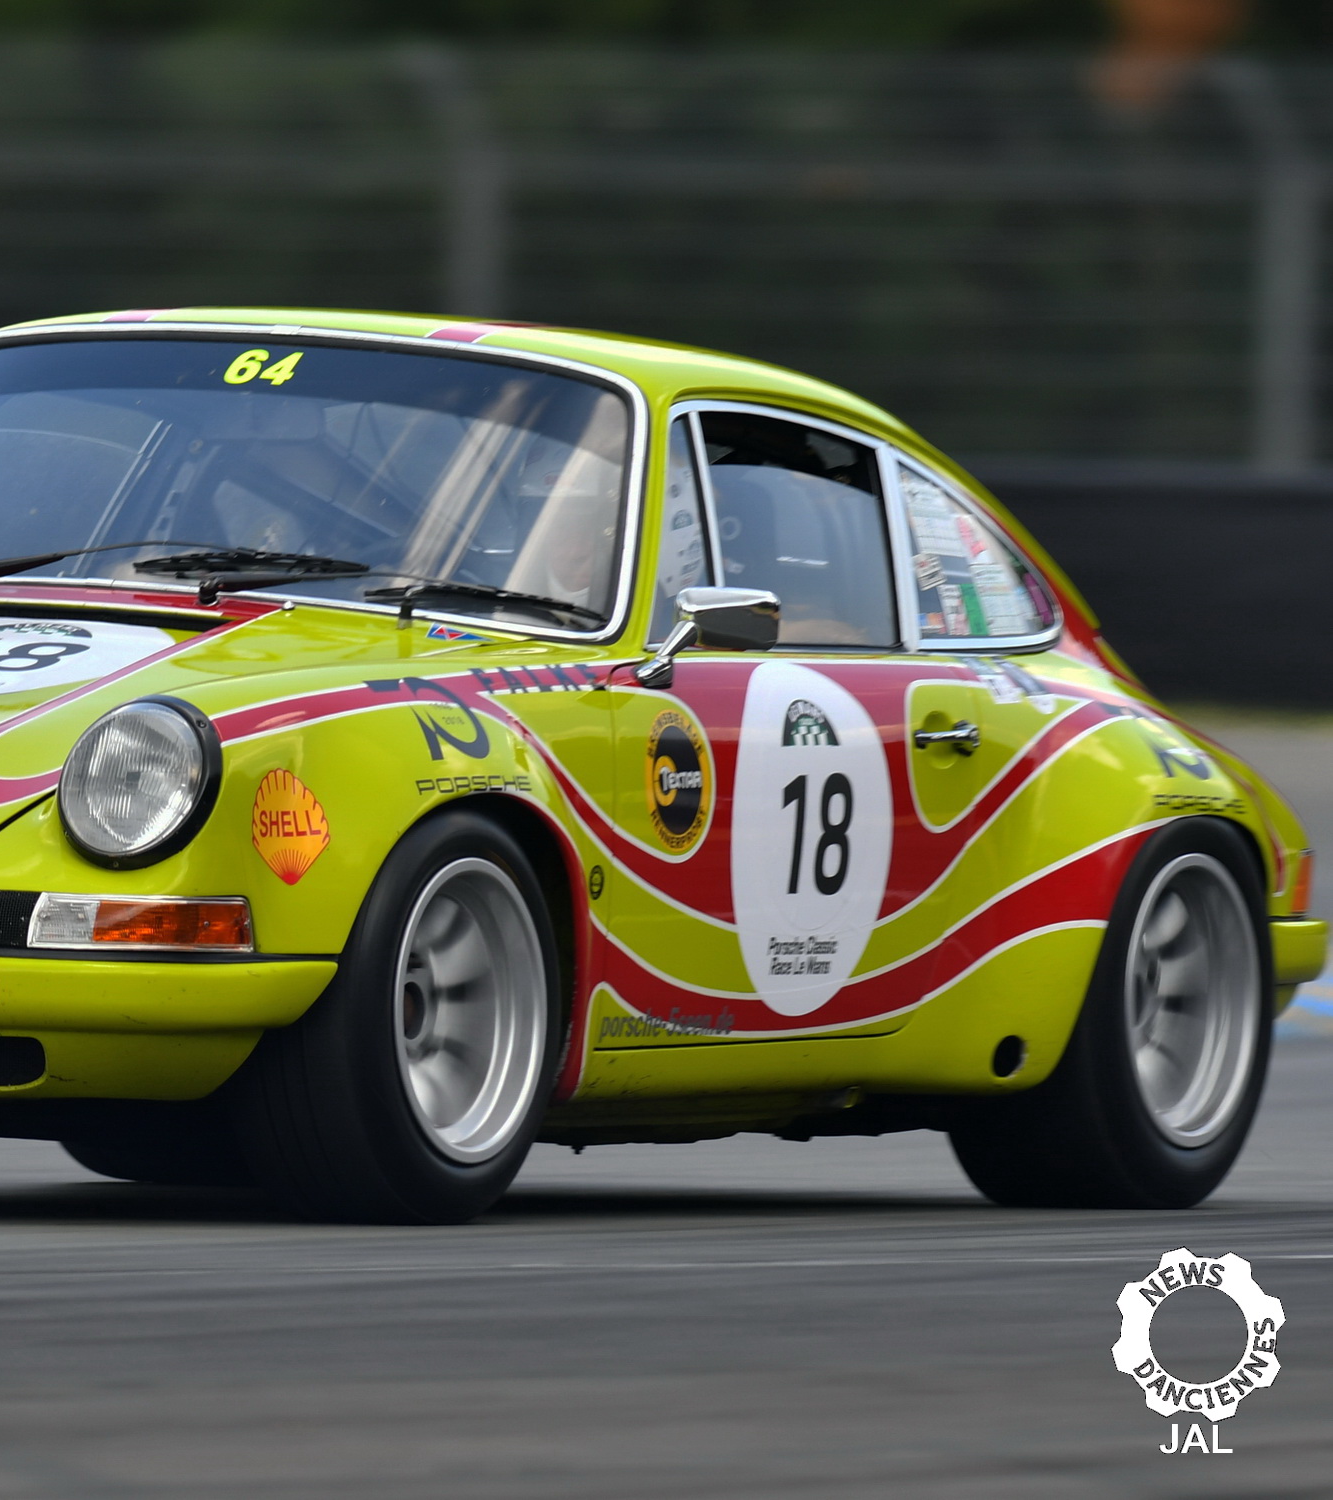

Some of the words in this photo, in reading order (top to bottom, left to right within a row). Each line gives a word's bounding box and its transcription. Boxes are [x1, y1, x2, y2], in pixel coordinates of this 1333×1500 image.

[223, 348, 304, 386] 64
[363, 676, 490, 761] 70
[415, 775, 532, 795] PORSCHE
[259, 810, 322, 838] SHELL
[780, 773, 853, 895] 18
[767, 936, 805, 955] Porsche
